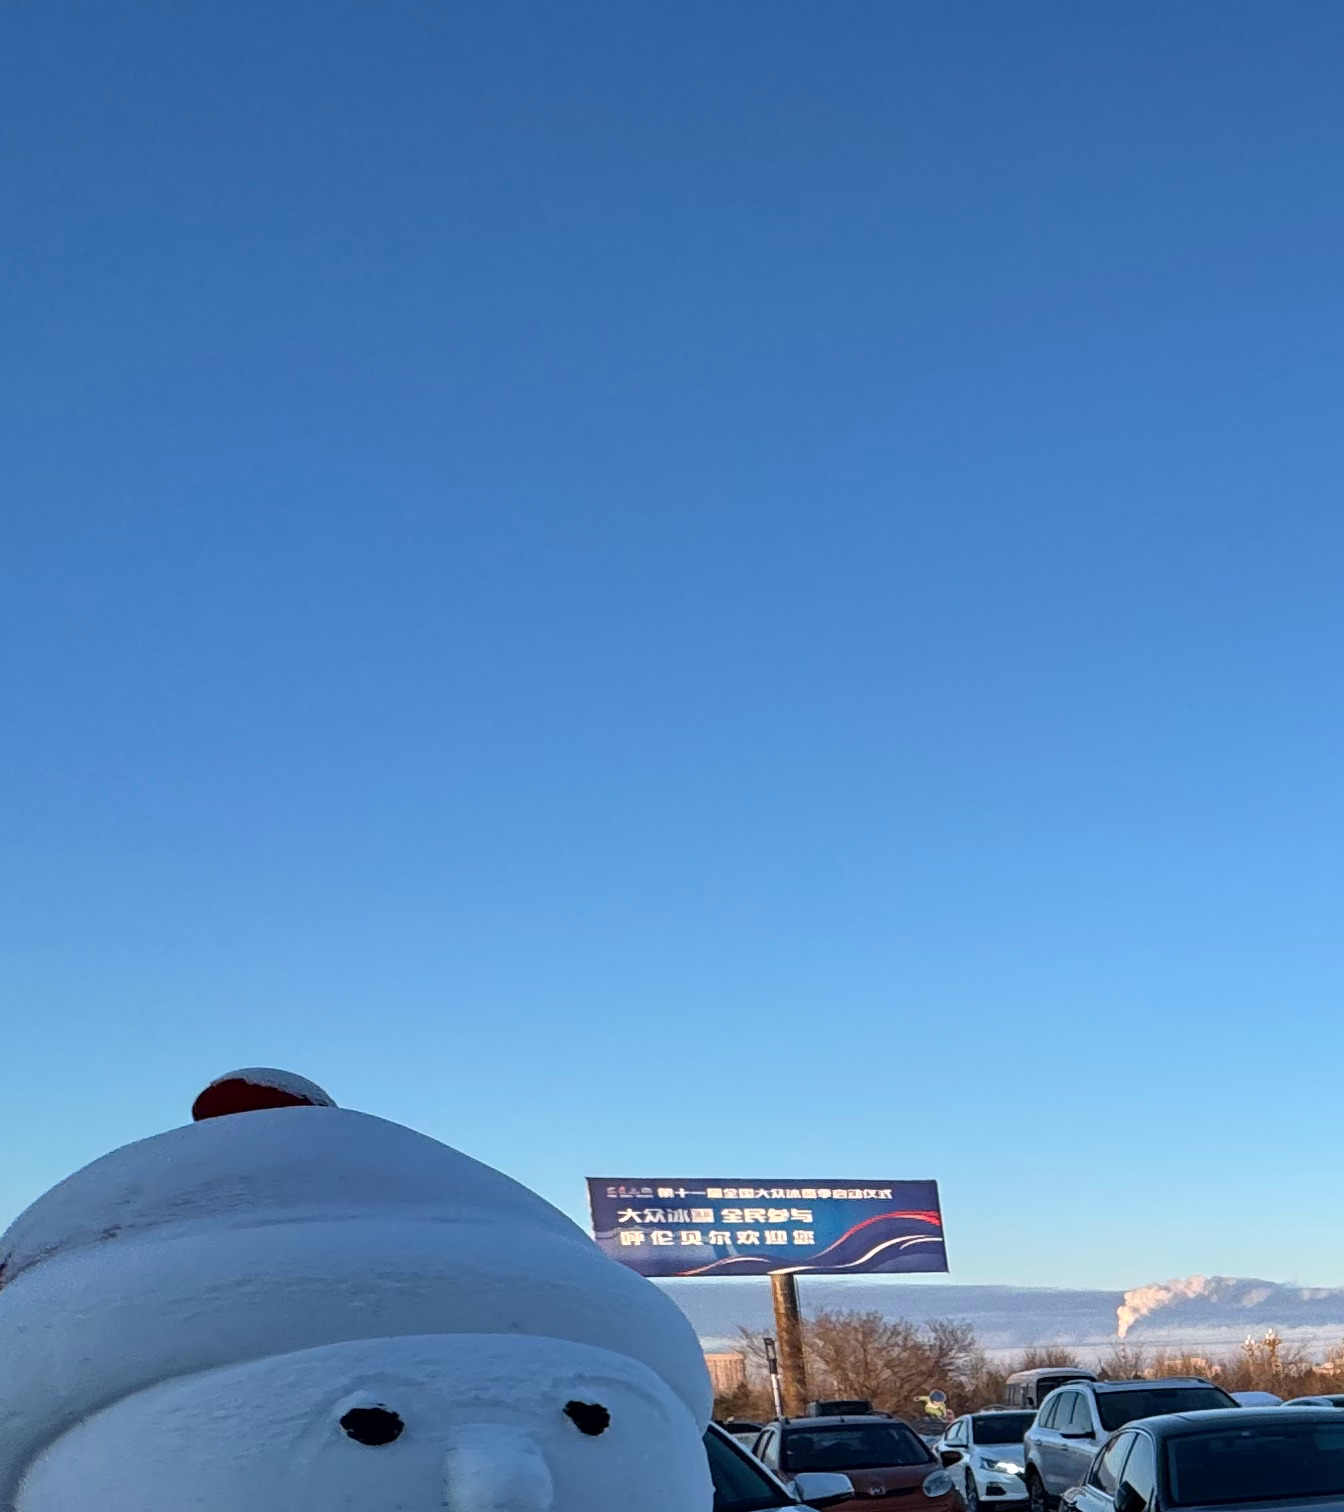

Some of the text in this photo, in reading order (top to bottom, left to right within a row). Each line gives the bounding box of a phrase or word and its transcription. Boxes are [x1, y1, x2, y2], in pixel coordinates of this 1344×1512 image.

[617, 1208, 813, 1223] 大众冰雪 全民参与
